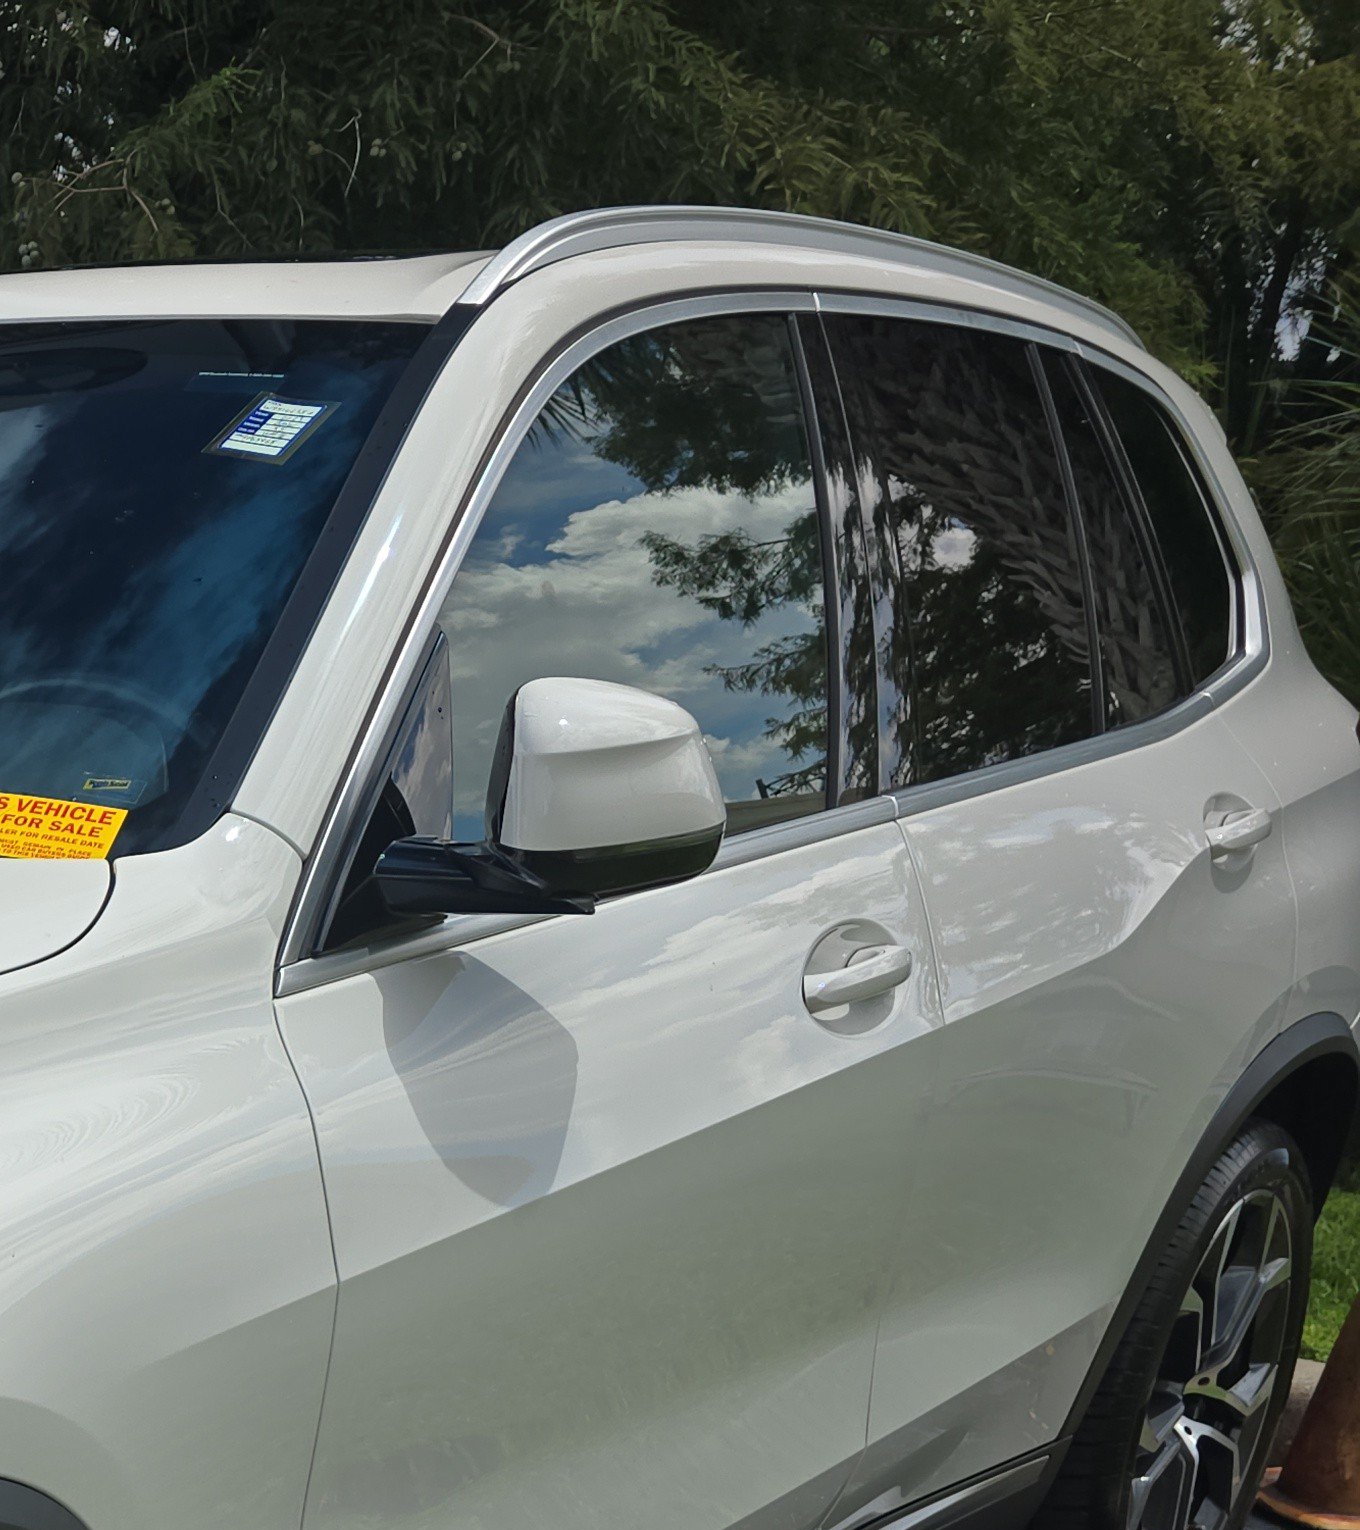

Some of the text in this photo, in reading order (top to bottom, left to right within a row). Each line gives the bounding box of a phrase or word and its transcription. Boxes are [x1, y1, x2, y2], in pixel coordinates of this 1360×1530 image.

[17, 798, 117, 825] VEHICLE
[1, 814, 43, 829] FOR
[48, 820, 103, 838] SALE
[19, 830, 39, 838] FOR
[40, 834, 78, 845] RESALE
[79, 839, 106, 849] DATE
